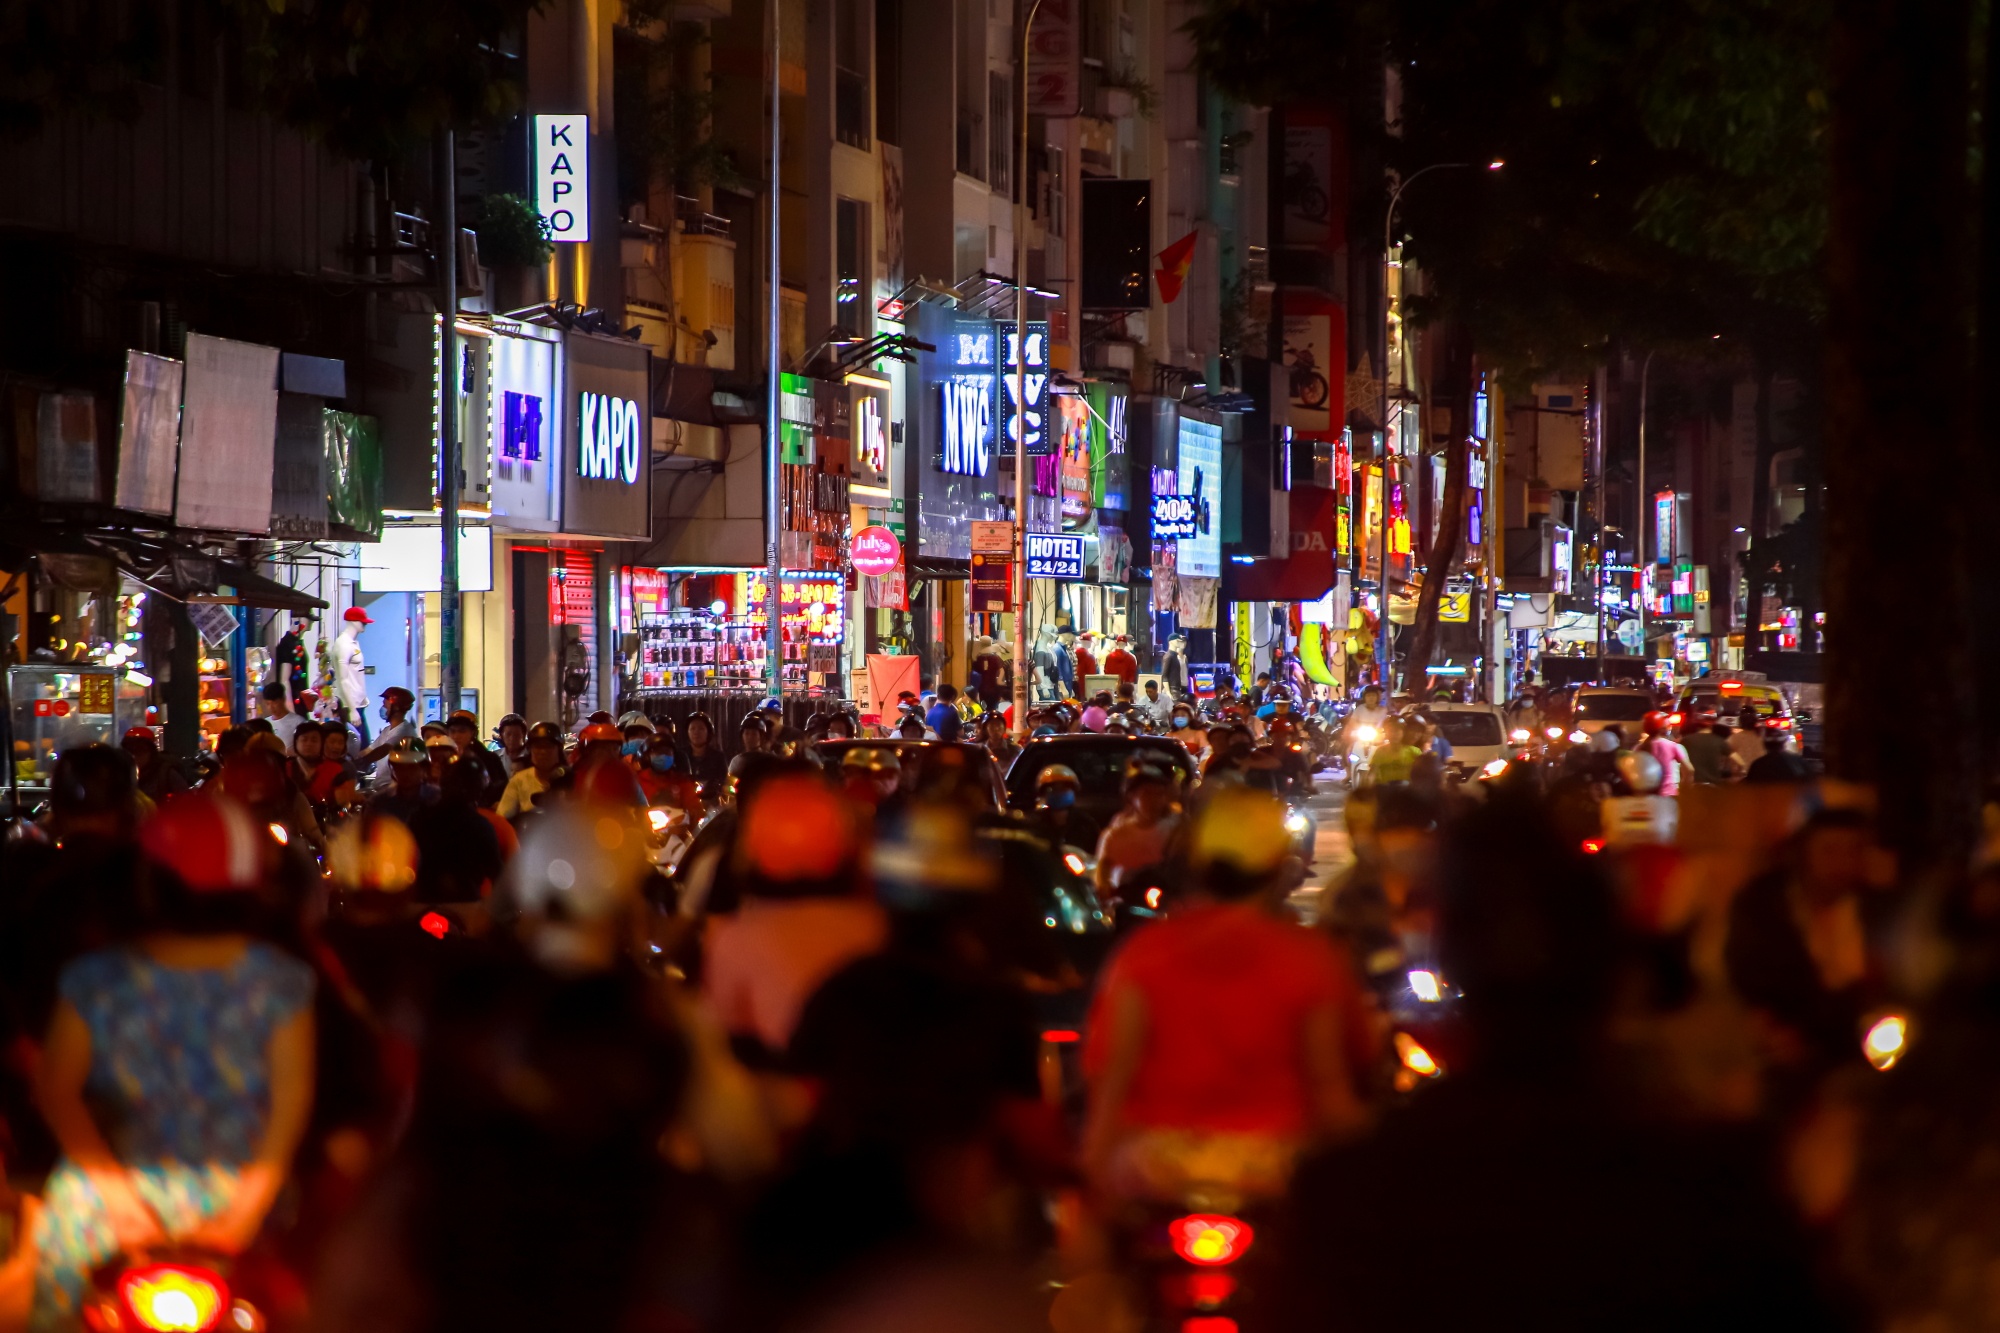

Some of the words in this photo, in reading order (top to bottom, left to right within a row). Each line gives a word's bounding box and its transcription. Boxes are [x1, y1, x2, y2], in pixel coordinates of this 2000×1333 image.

[550, 124, 575, 233] KAPO
[942, 380, 990, 477] MWC
[1003, 333, 1046, 445] MWC
[580, 391, 639, 485] KAPO
[1030, 538, 1080, 559] HOTEL
[1156, 499, 1192, 521] 404
[1031, 560, 1078, 574] 24/24
